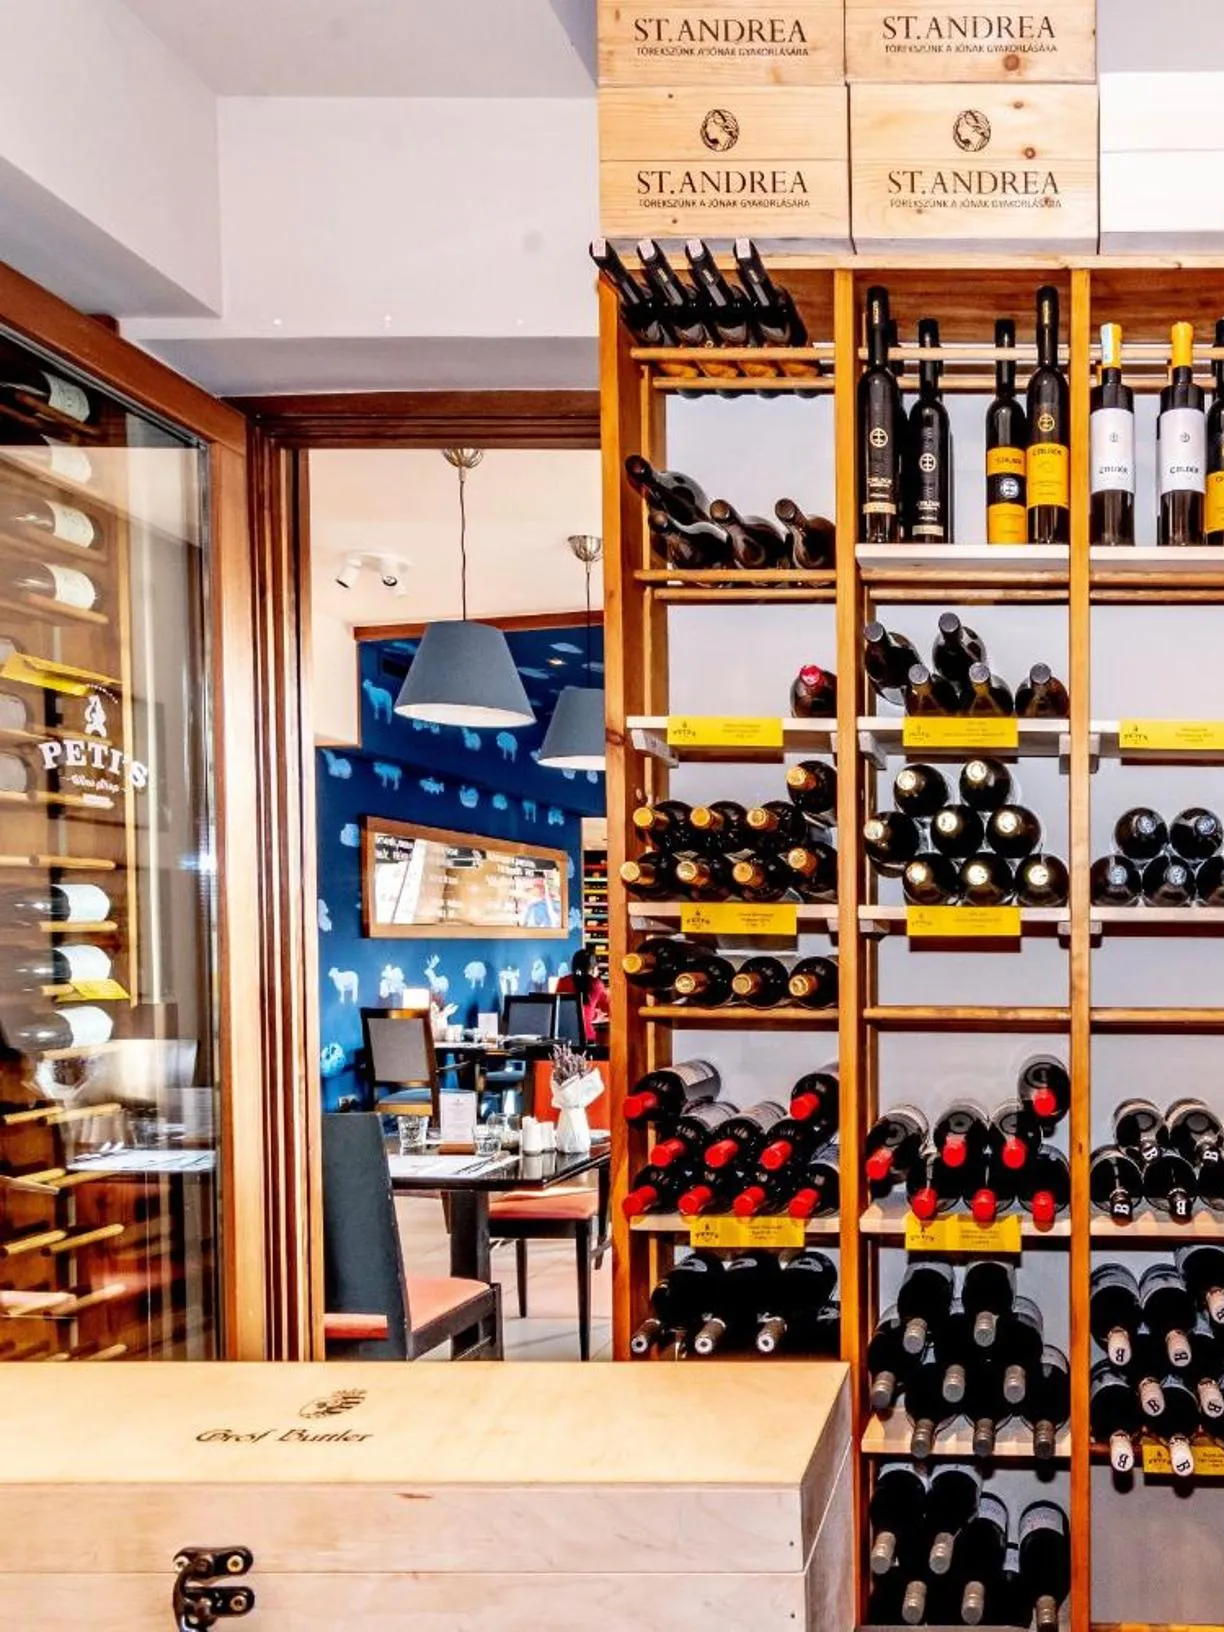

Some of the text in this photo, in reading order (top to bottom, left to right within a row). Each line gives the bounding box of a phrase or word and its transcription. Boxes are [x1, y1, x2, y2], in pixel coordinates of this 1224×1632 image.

[634, 18, 807, 43] ST.ANDREA
[882, 15, 1056, 40] ST.ANDREA
[637, 170, 808, 195] ST.ANDREA
[887, 170, 1059, 195] ST.ANDREA
